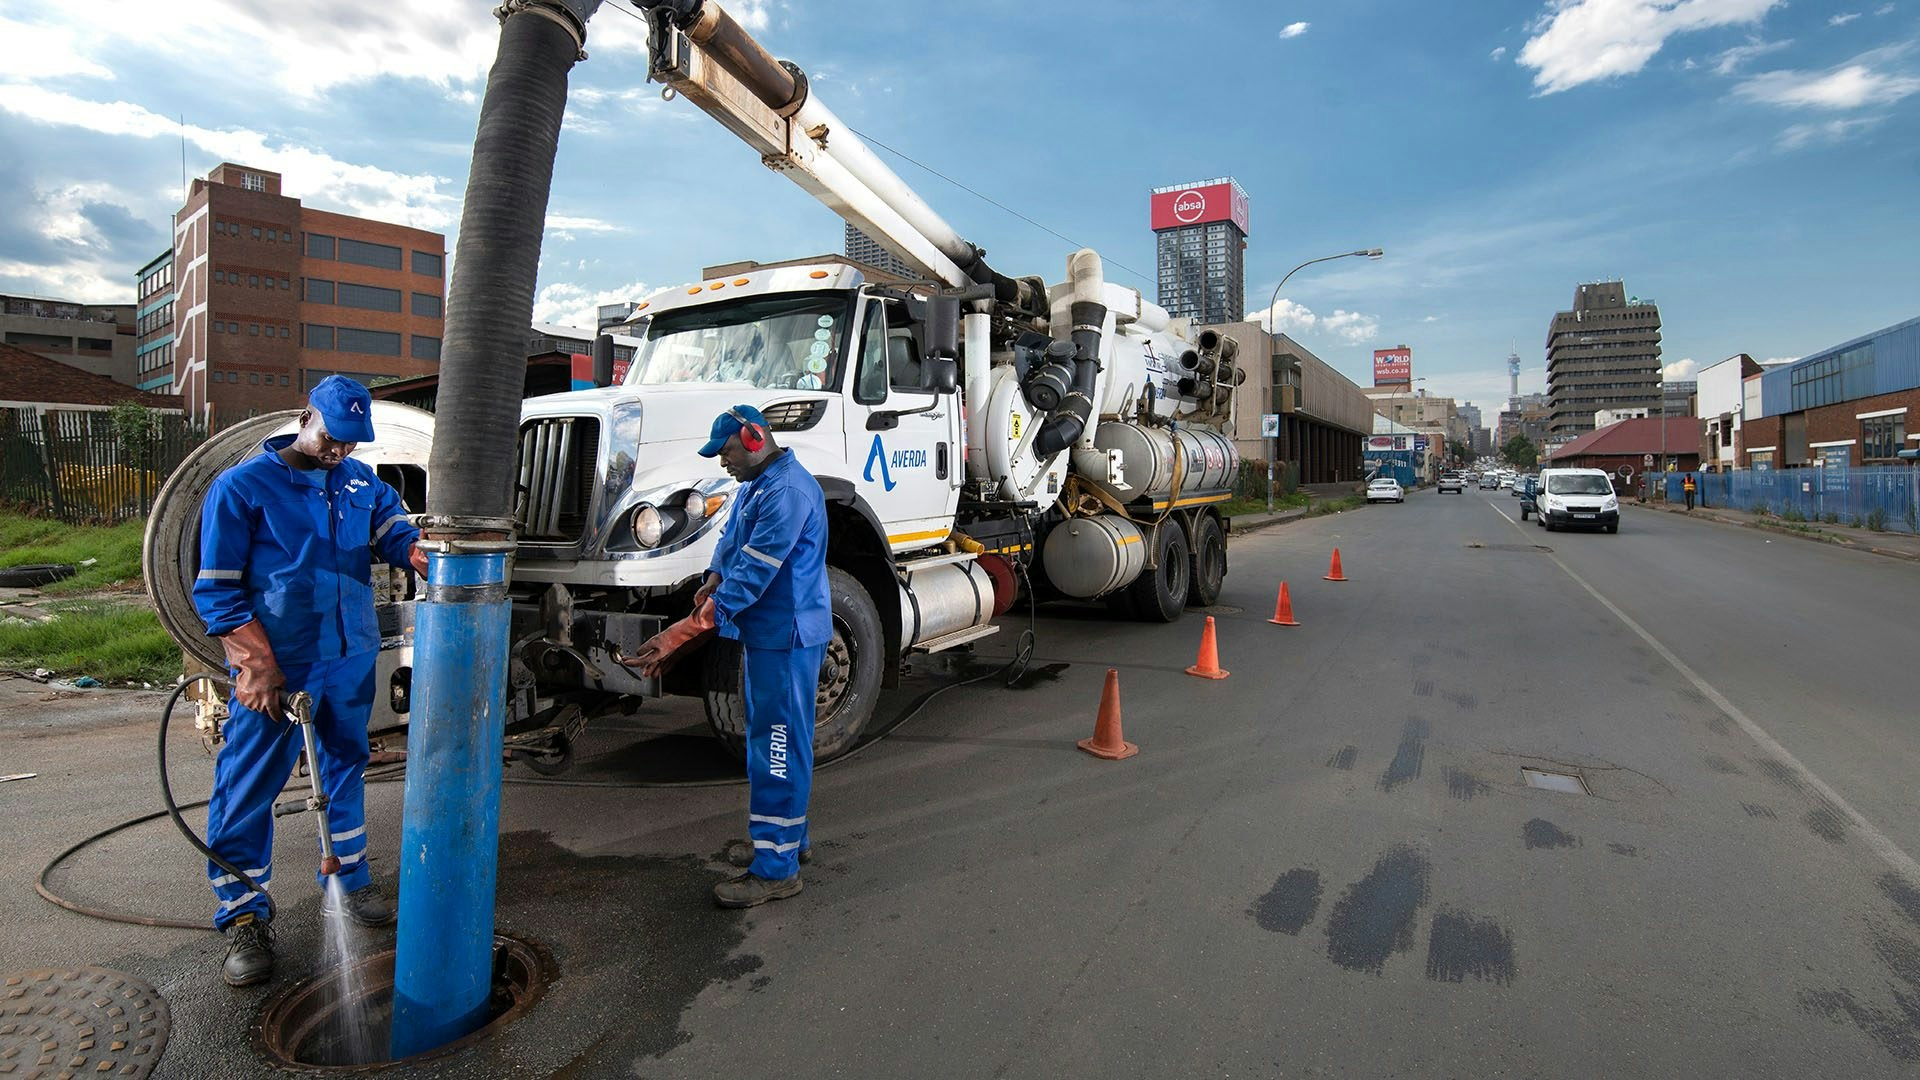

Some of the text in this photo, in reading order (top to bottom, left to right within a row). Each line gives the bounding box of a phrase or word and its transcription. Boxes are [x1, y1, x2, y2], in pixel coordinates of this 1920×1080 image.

[1178, 201, 1202, 212] absa
[890, 449, 927, 468] AVERDA
[769, 724, 787, 779] AVERDA
